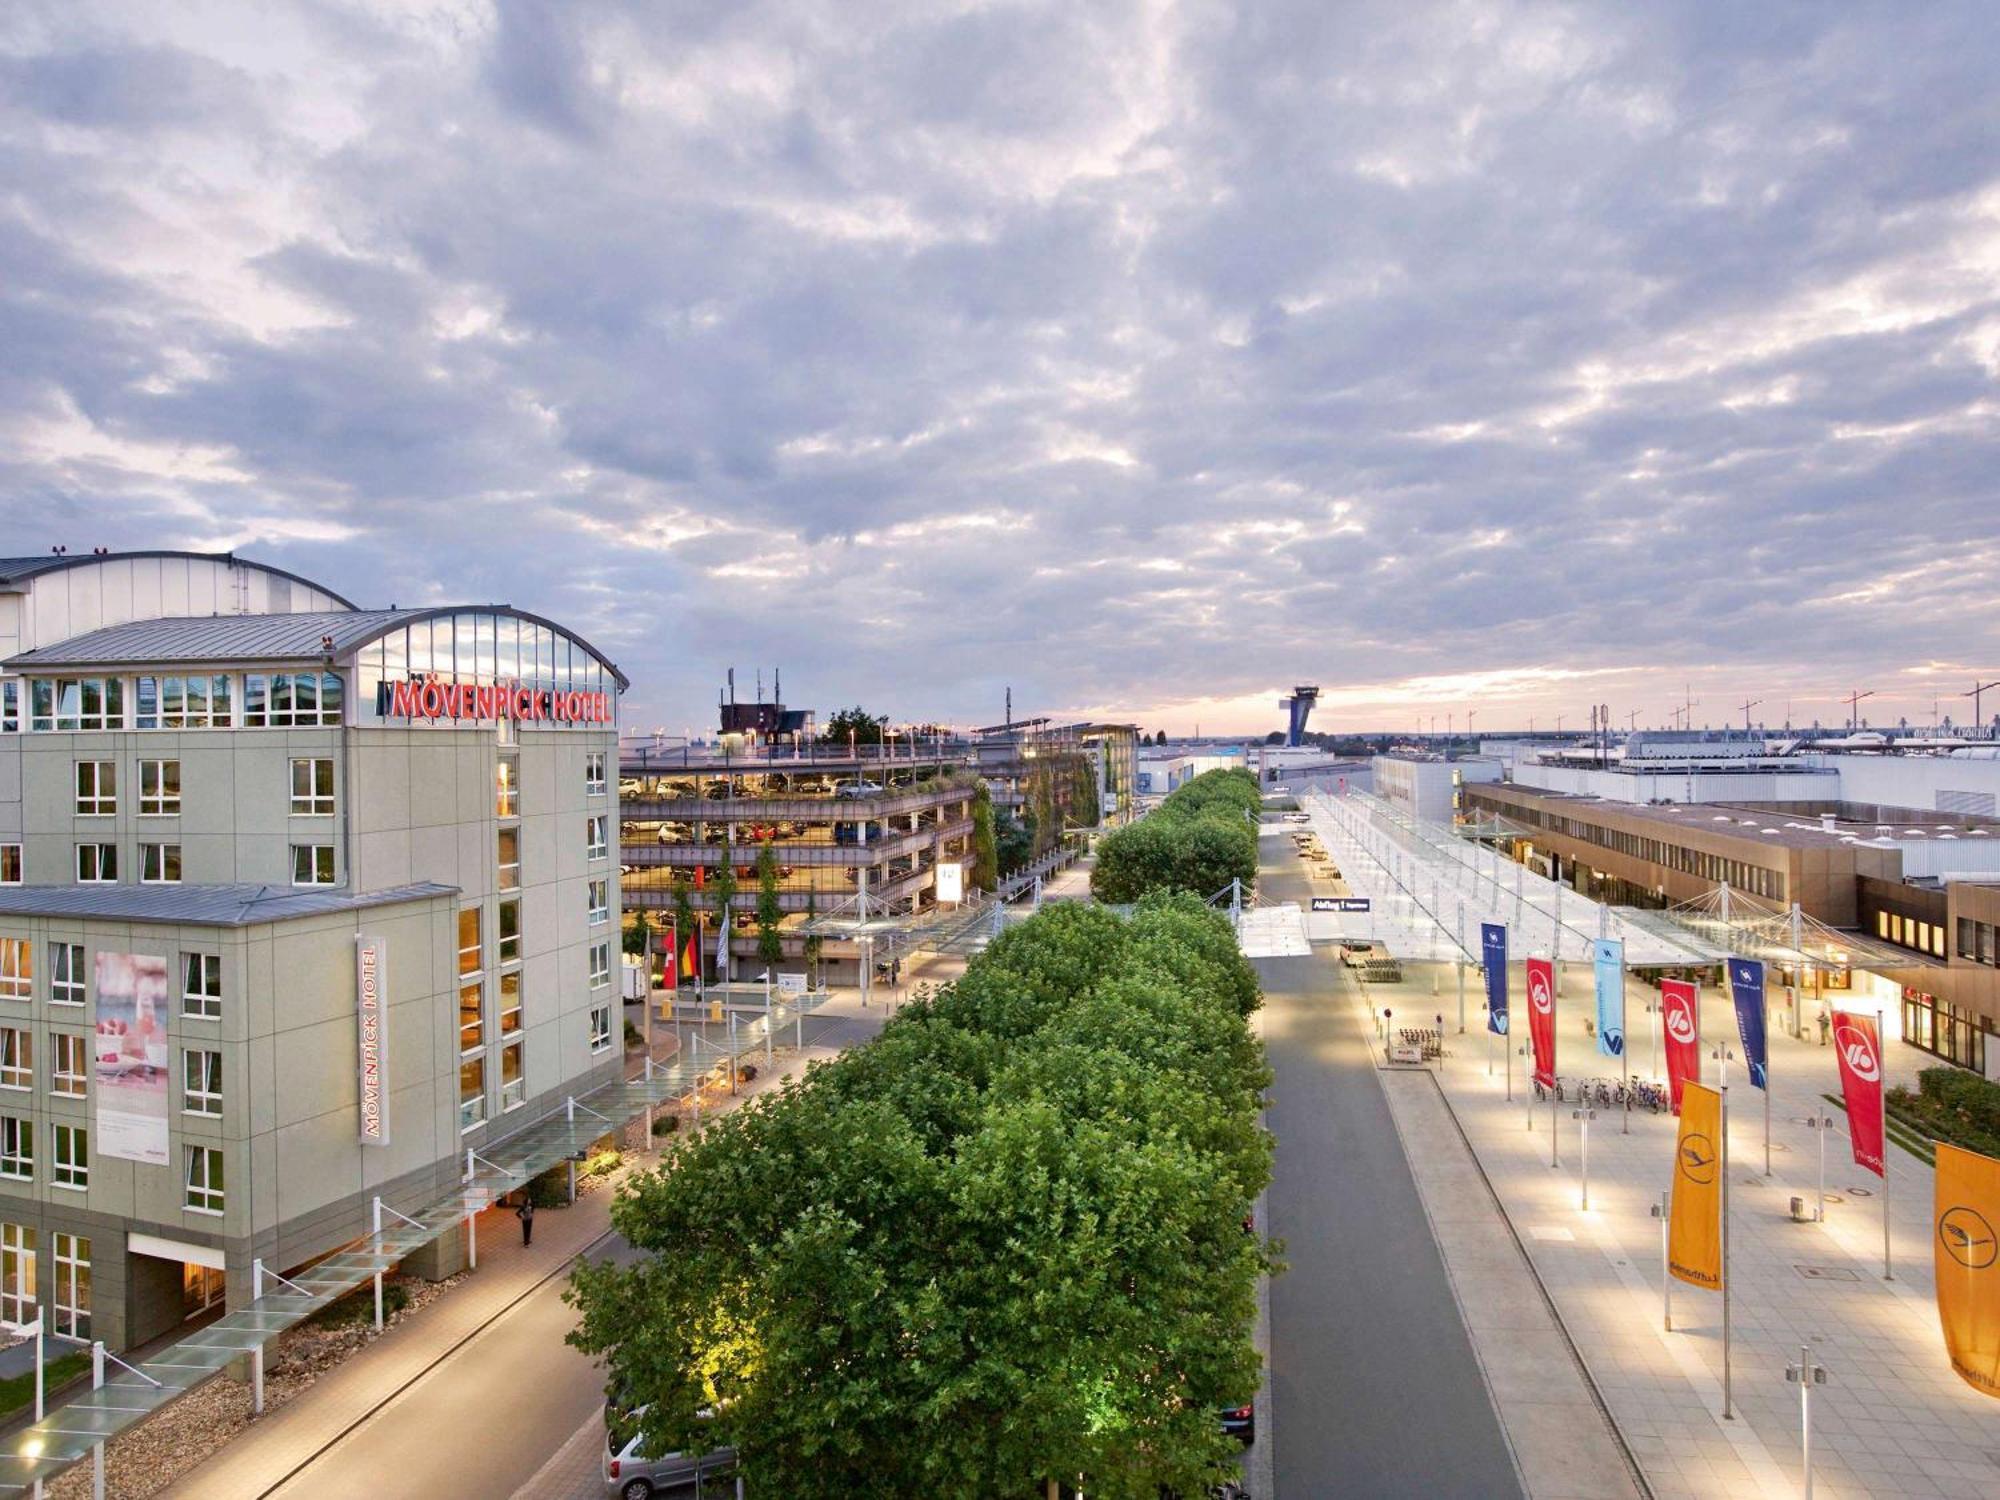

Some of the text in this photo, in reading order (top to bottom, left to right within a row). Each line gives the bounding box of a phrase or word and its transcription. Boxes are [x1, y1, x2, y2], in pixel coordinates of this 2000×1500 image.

[391, 673, 612, 723] MÖVENPICK HOTEL
[360, 947, 380, 1138] MÖVENPICK HOTEL
